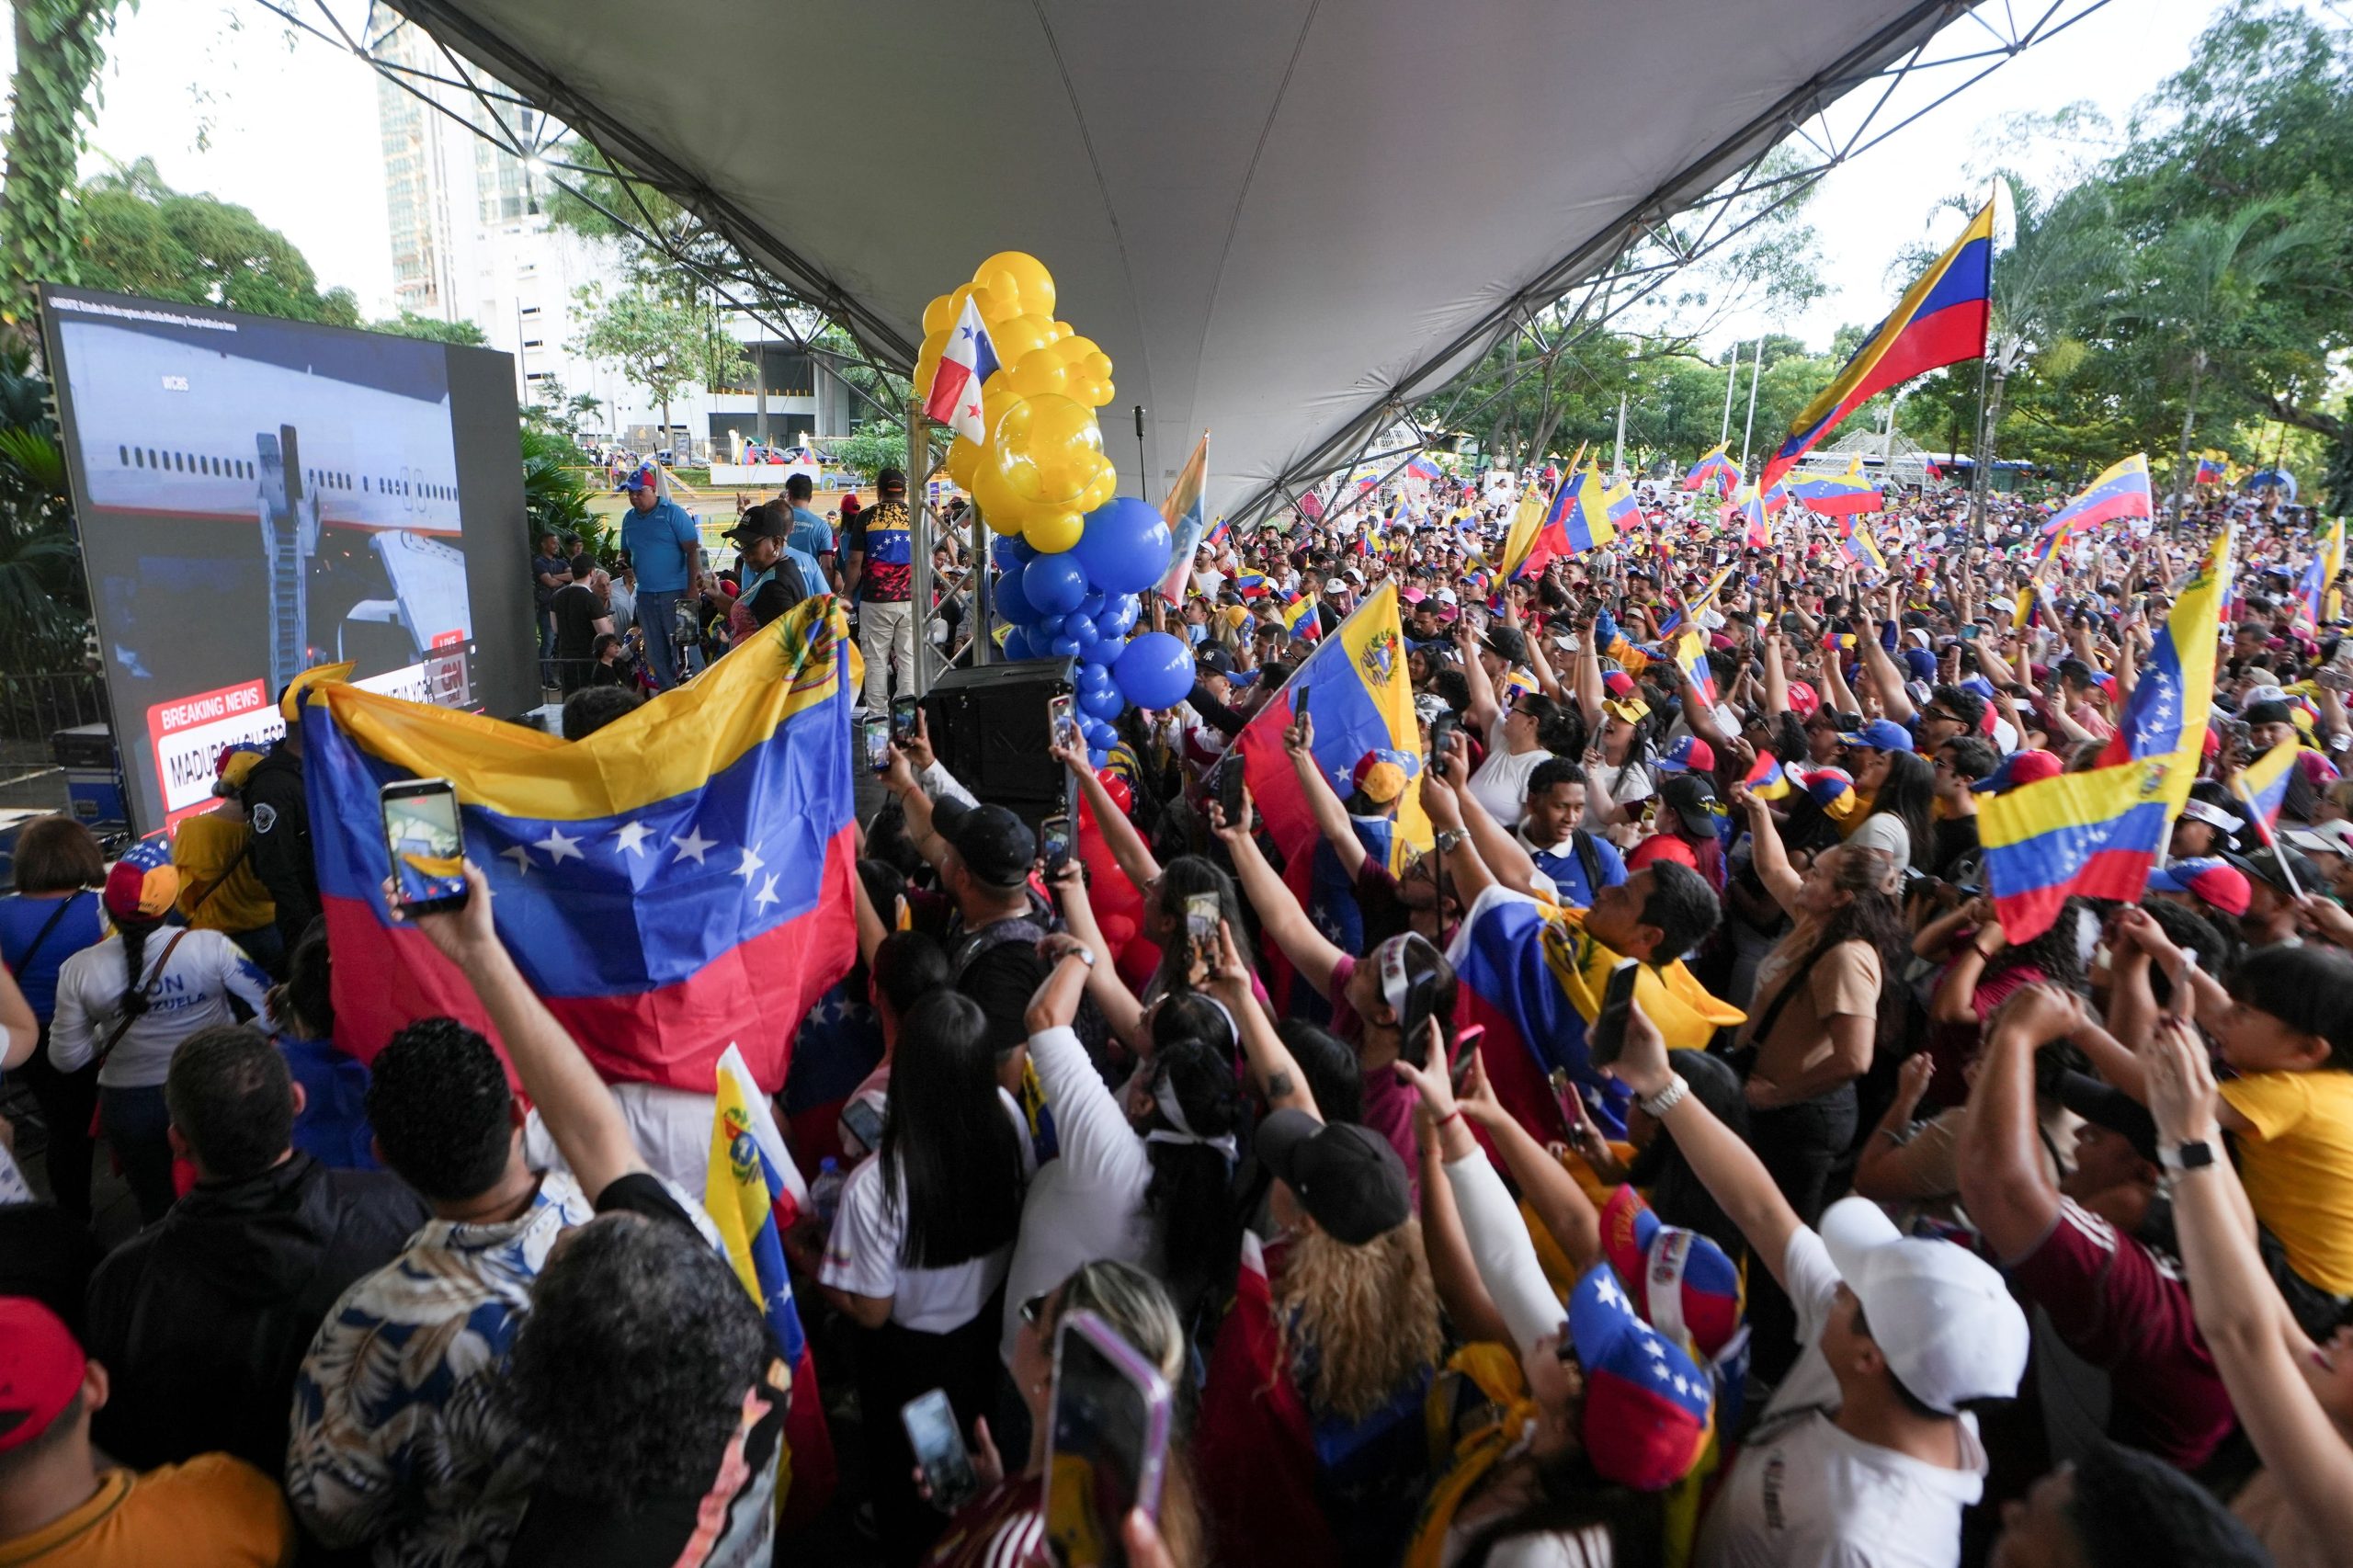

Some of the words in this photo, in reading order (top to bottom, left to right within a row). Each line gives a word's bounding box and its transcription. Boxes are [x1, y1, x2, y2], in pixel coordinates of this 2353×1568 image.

[161, 695, 224, 731] BREAKING
[224, 687, 259, 713] NEWS
[170, 741, 227, 790] MADUR
